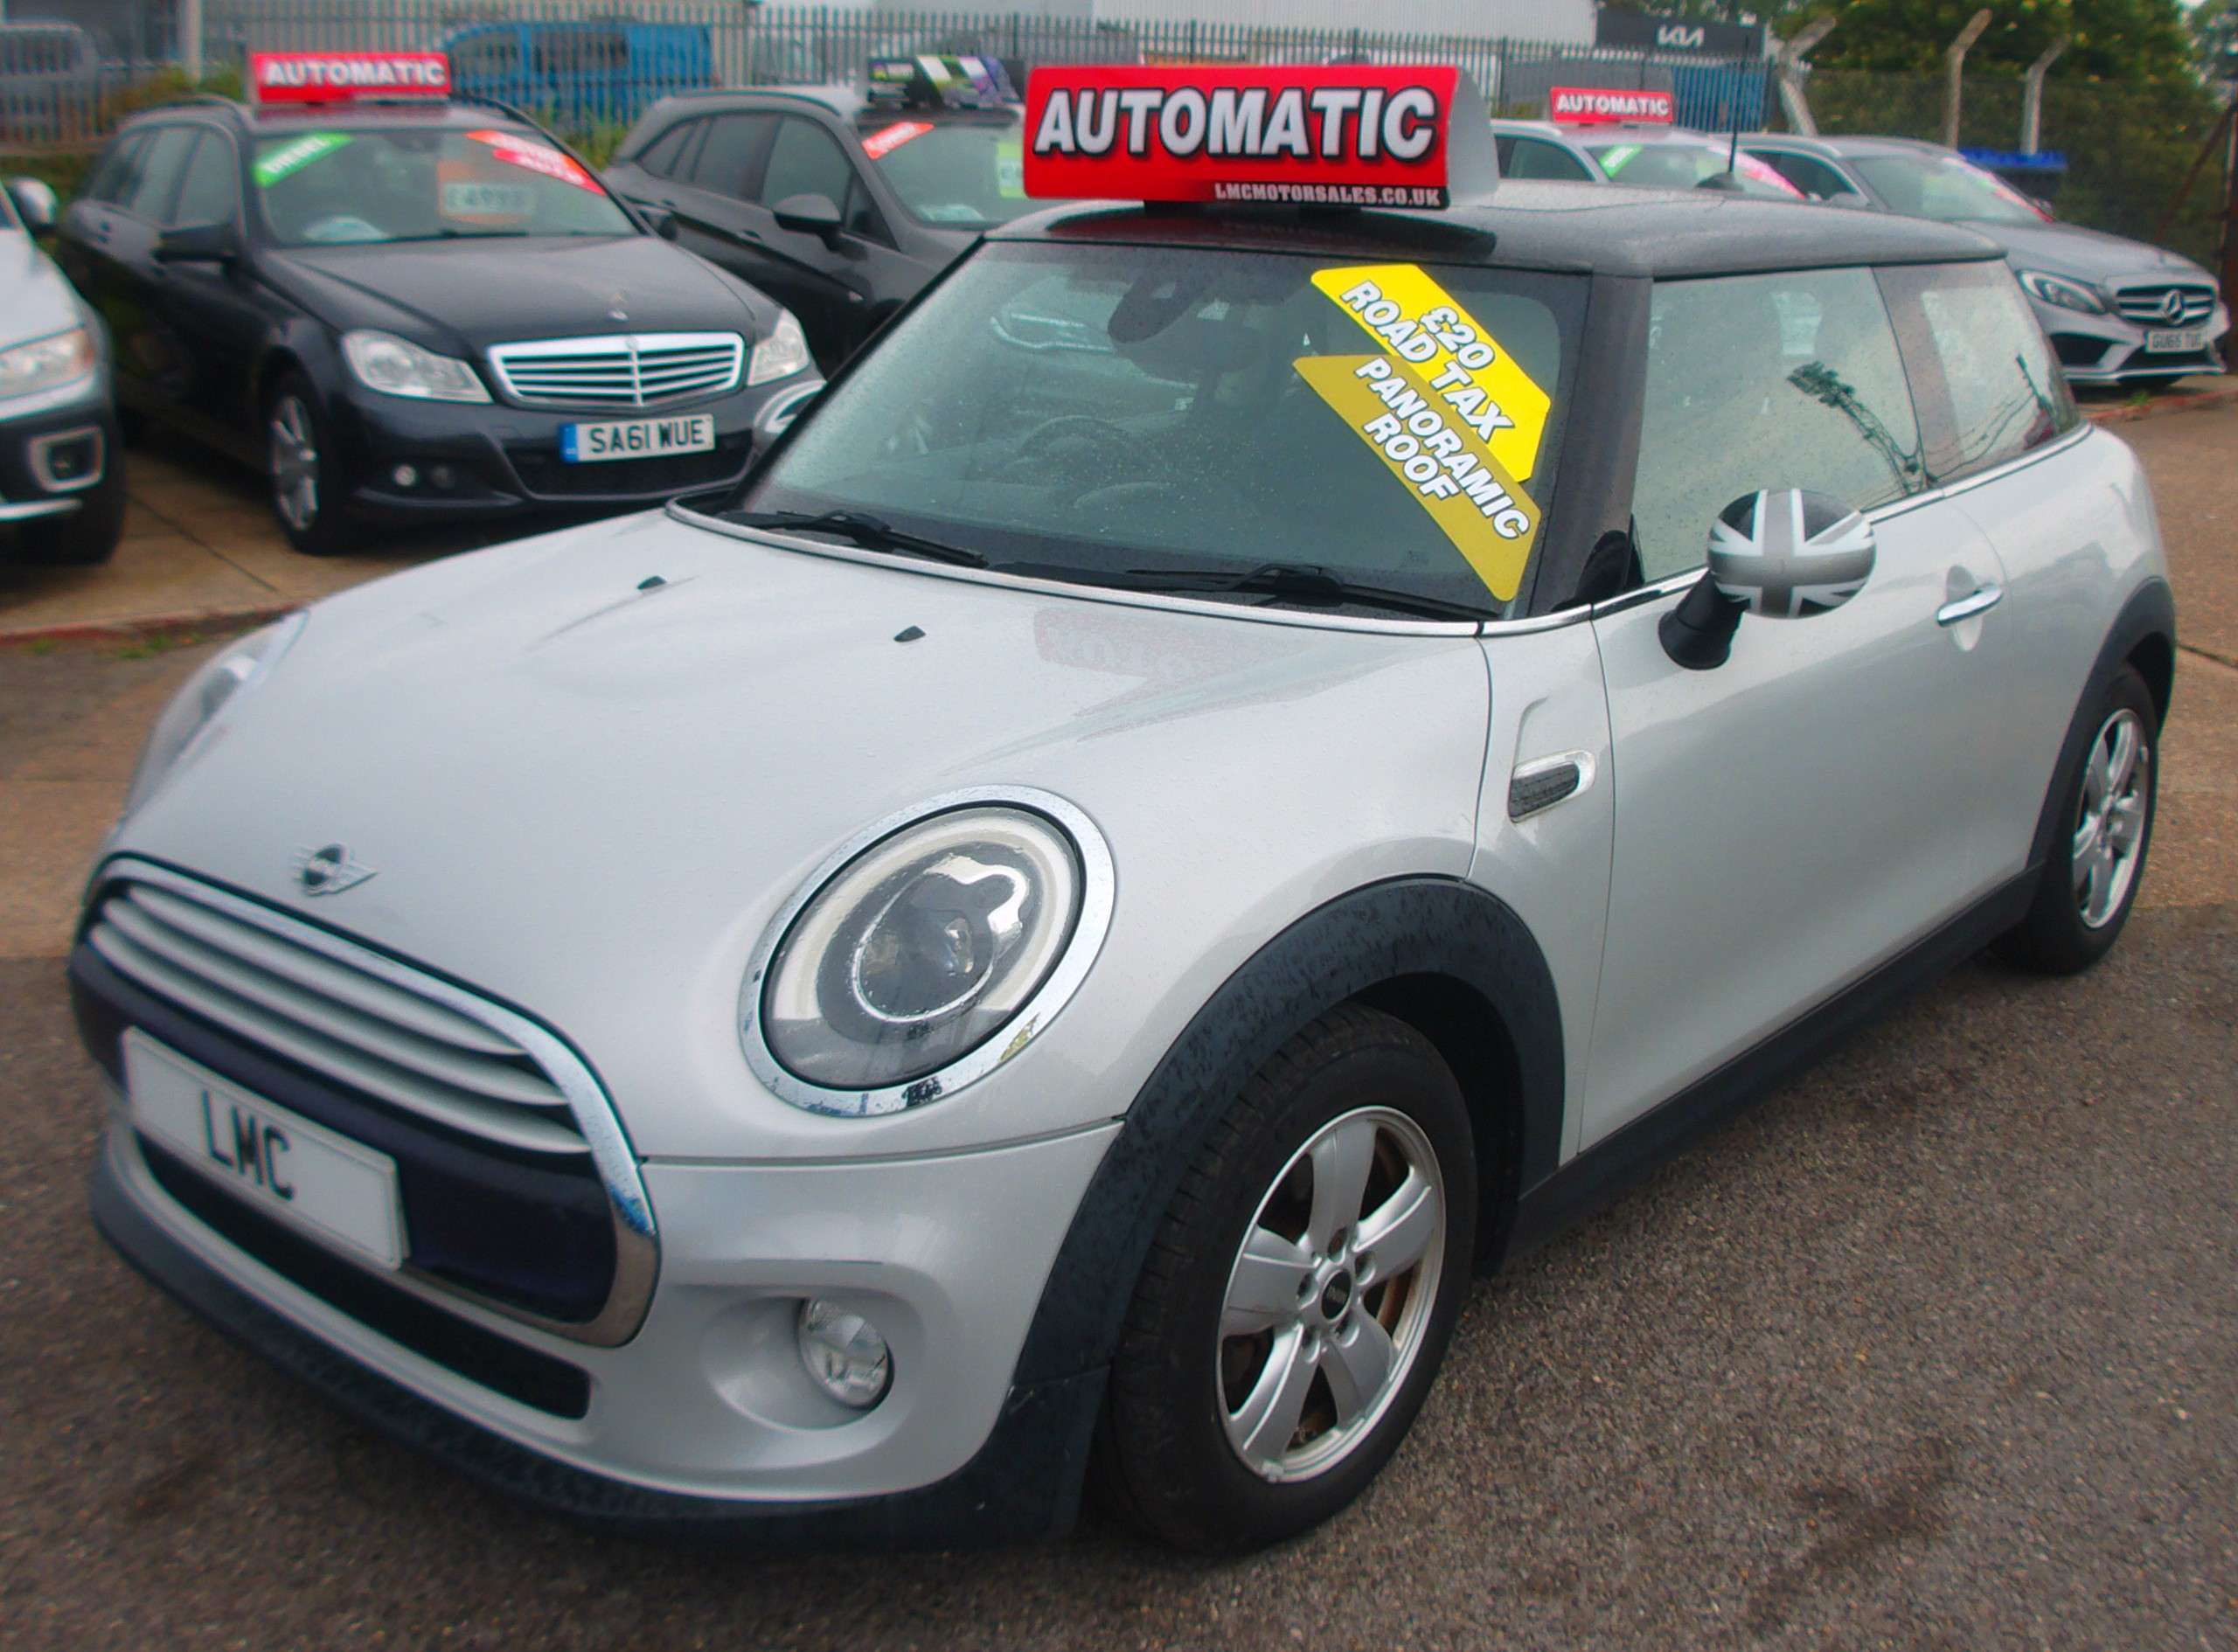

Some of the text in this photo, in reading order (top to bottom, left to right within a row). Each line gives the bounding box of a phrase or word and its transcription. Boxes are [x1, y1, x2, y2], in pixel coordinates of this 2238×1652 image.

[1658, 25, 1704, 46] KIA
[264, 59, 447, 86] AUTOMATIC
[1556, 94, 1669, 115] AUTOMATIC
[1033, 88, 1438, 161] AUTOMATIC
[1213, 182, 1442, 207] LMCMOTORSALES.CO.UK
[1340, 280, 1515, 444] ROAD TAX
[1420, 306, 1496, 371] £20
[588, 419, 705, 454] SA61 WUE
[1354, 357, 1531, 539] PANORAMIC
[1363, 413, 1460, 501] ROOF
[201, 1090, 295, 1202] LMC
